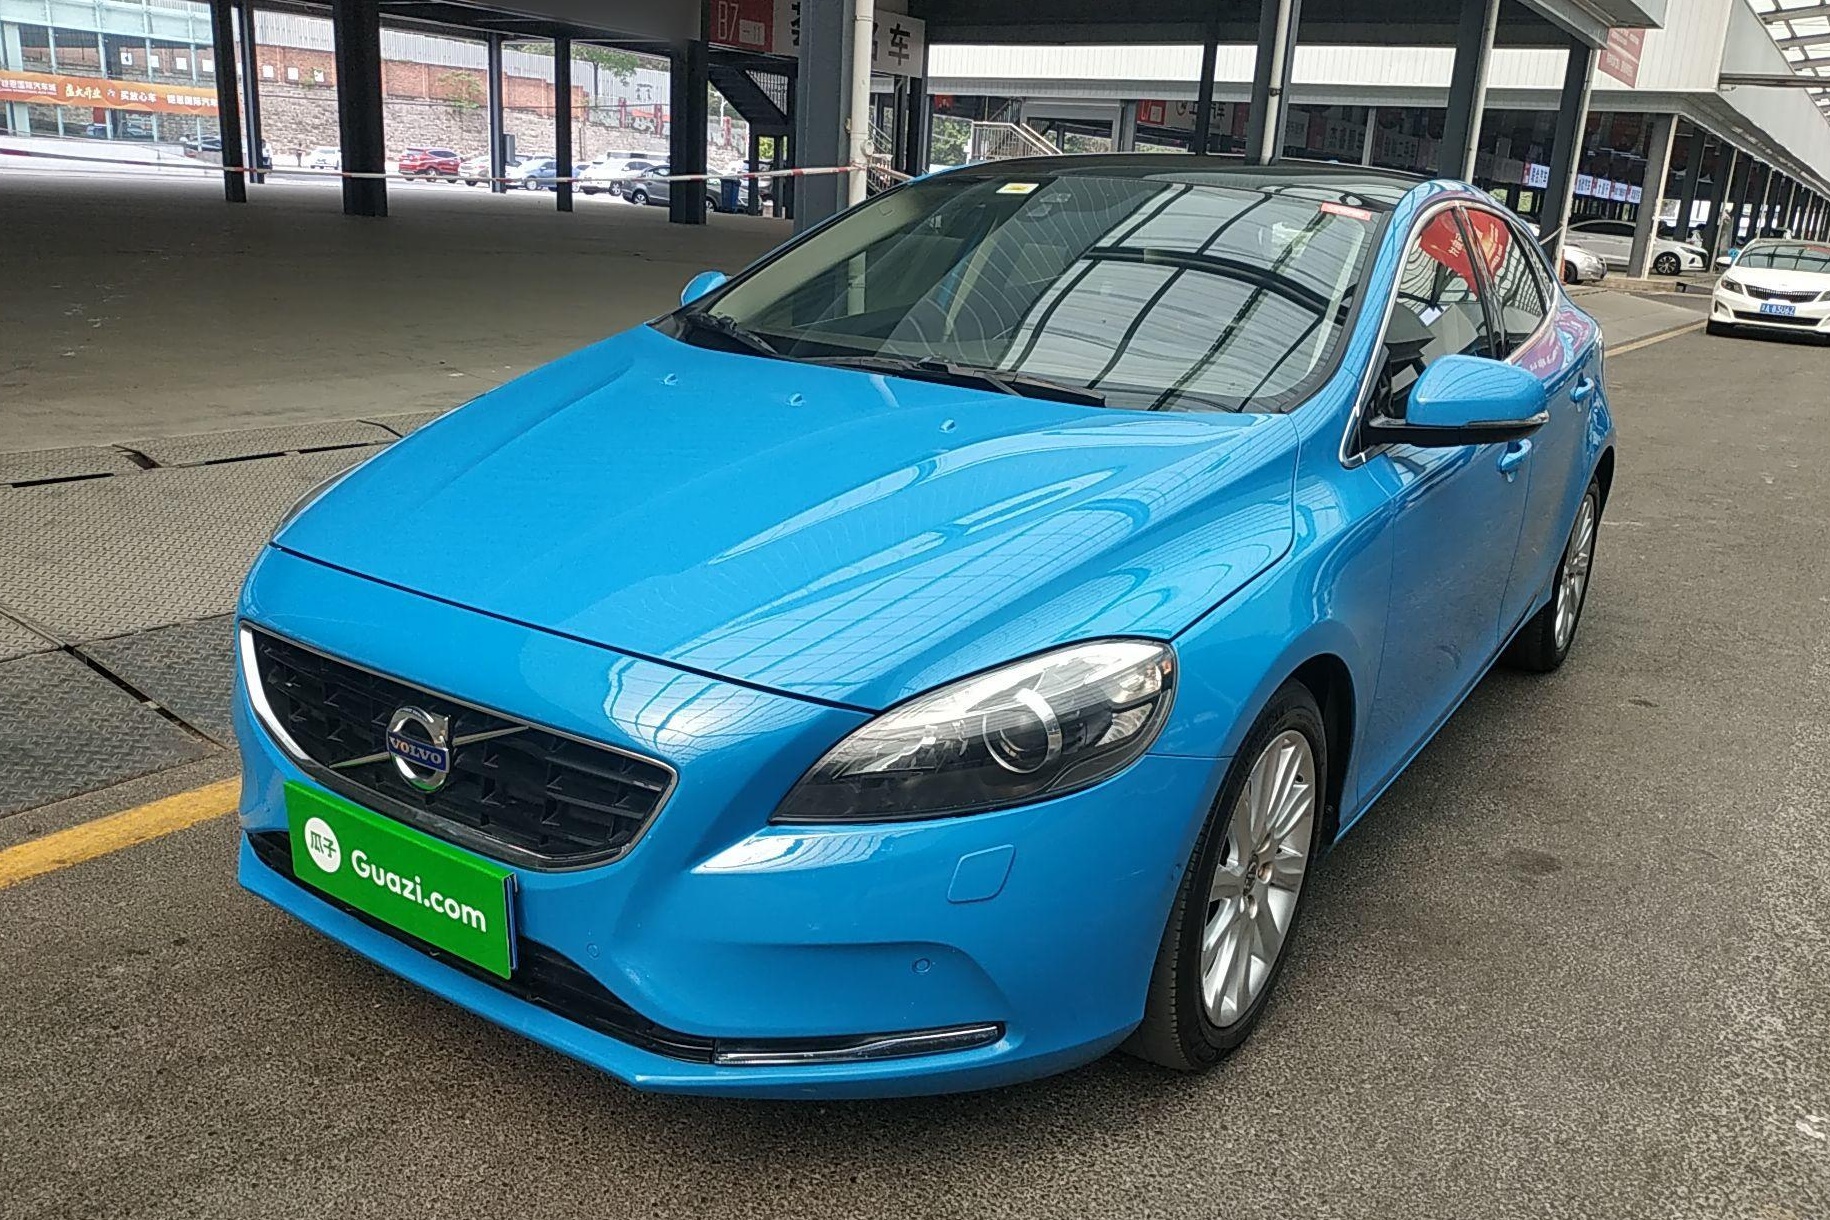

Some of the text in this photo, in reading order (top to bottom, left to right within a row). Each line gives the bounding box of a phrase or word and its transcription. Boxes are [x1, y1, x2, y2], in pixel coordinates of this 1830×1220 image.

[718, 1, 740, 41] B7
[65, 83, 102, 100] 盛大开业
[120, 90, 157, 103] 买放心车
[388, 736, 442, 765] VOLVO
[310, 830, 336, 858] 瓜子
[351, 849, 487, 933] Guazi.com
